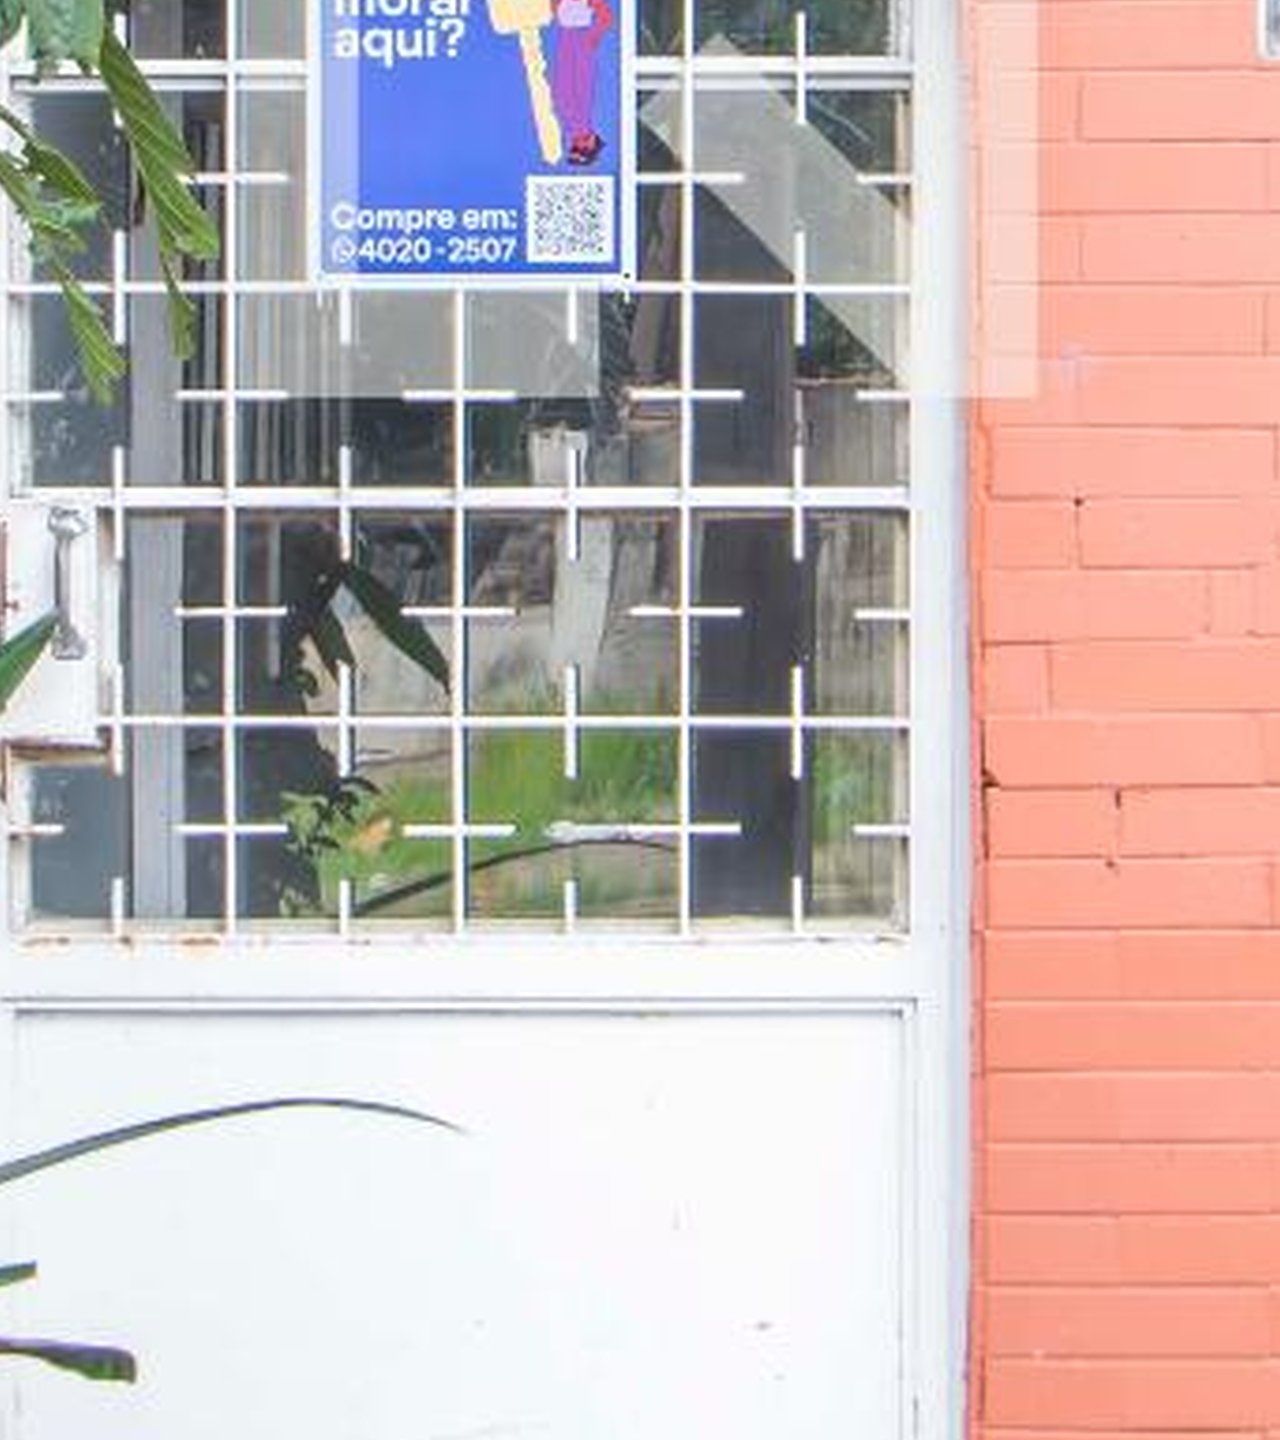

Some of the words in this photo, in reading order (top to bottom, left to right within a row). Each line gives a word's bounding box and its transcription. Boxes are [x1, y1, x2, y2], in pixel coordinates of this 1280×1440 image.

[335, 17, 466, 69] aqui?
[331, 203, 456, 234] Compre
[462, 207, 518, 230] em:
